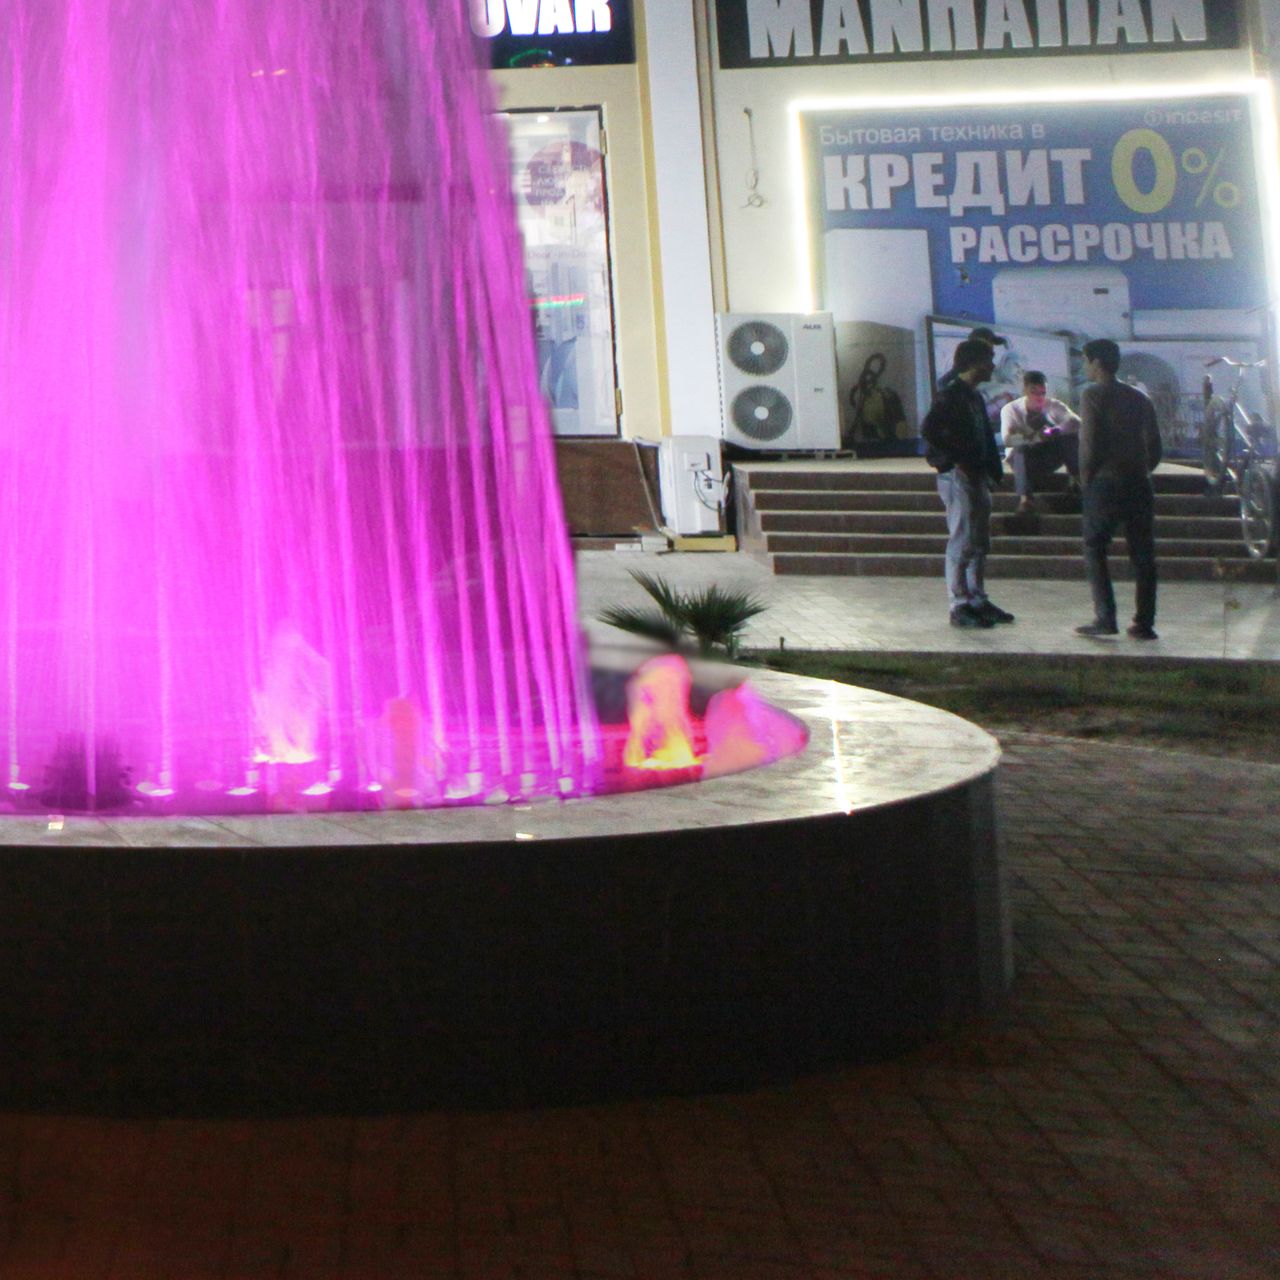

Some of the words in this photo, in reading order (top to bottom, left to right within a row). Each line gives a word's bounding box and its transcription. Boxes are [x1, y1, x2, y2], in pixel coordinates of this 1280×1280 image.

[818, 124, 922, 145] Бытовая
[929, 123, 1024, 140] техника
[1031, 124, 1045, 139] в
[823, 147, 1093, 217] КРЕДИТ
[948, 221, 1234, 264] РАССРОЧКА
